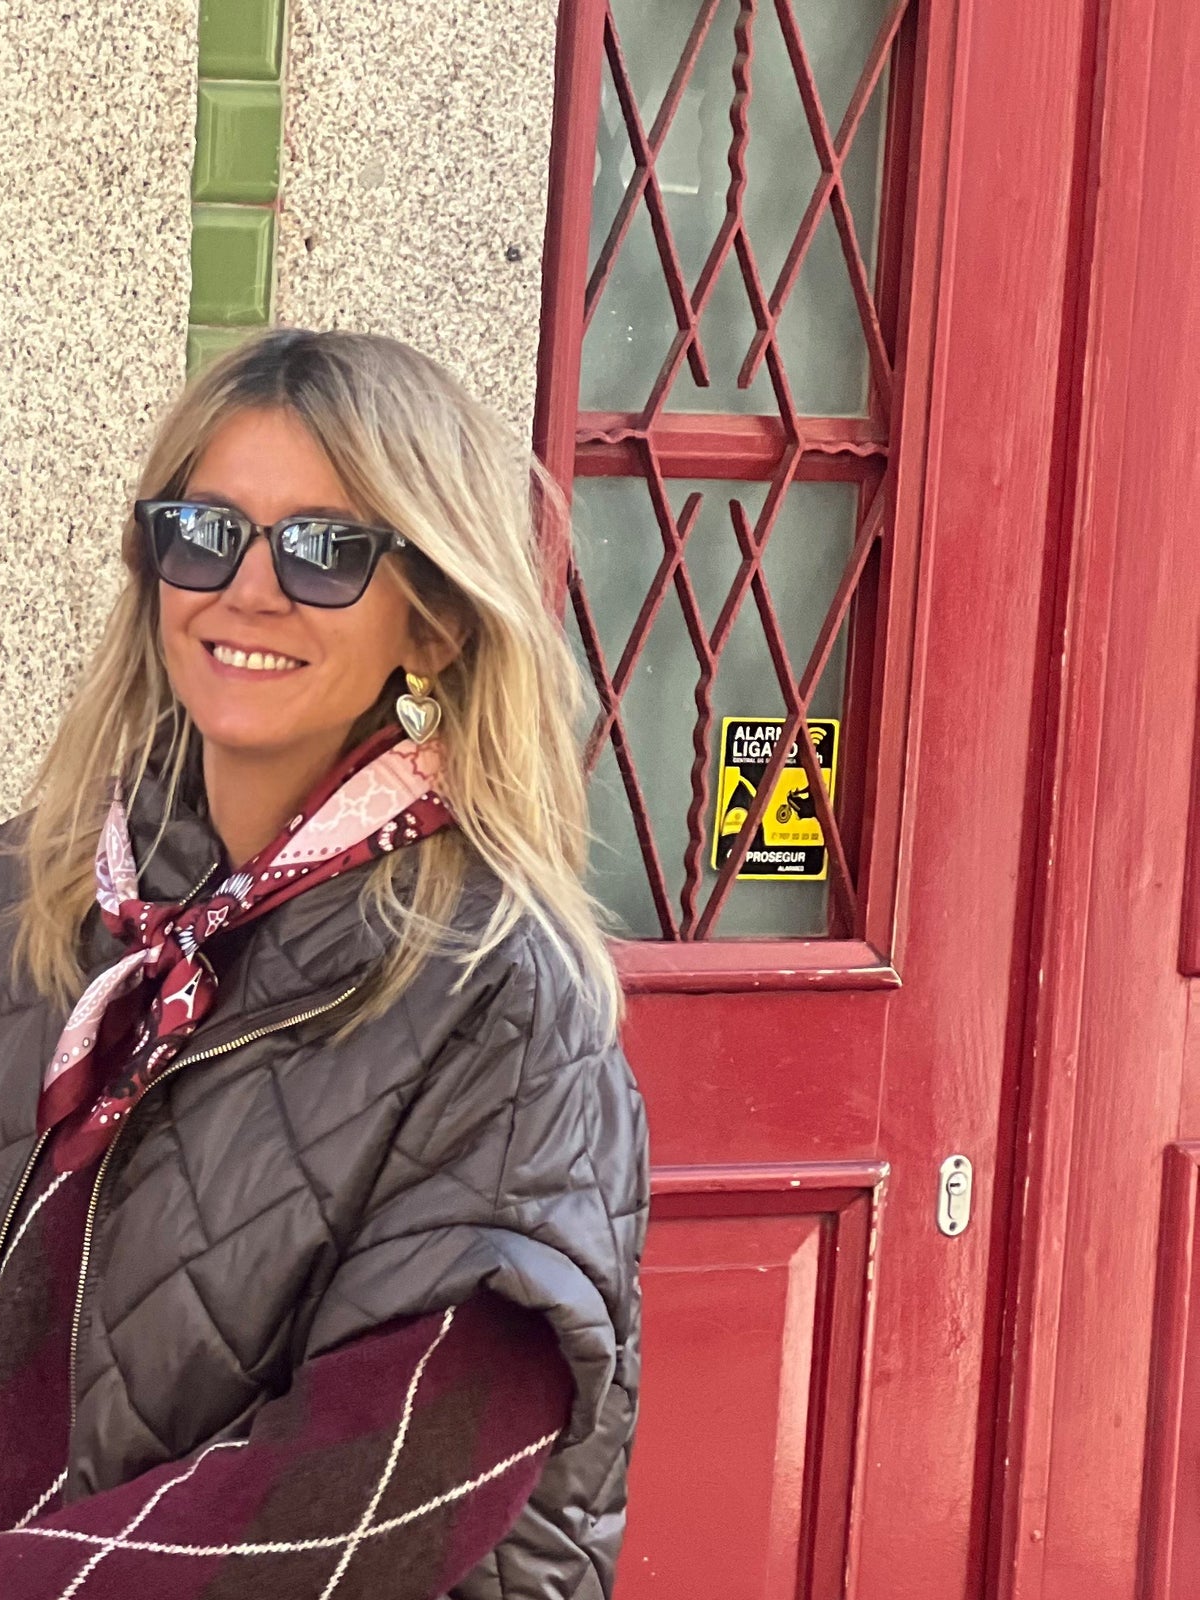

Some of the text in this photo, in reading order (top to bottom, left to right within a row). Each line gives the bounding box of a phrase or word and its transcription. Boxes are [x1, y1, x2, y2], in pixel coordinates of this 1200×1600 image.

[734, 726, 783, 741] ALAR
[732, 741, 799, 757] LIGAO
[745, 851, 806, 862] PROSEGUR
